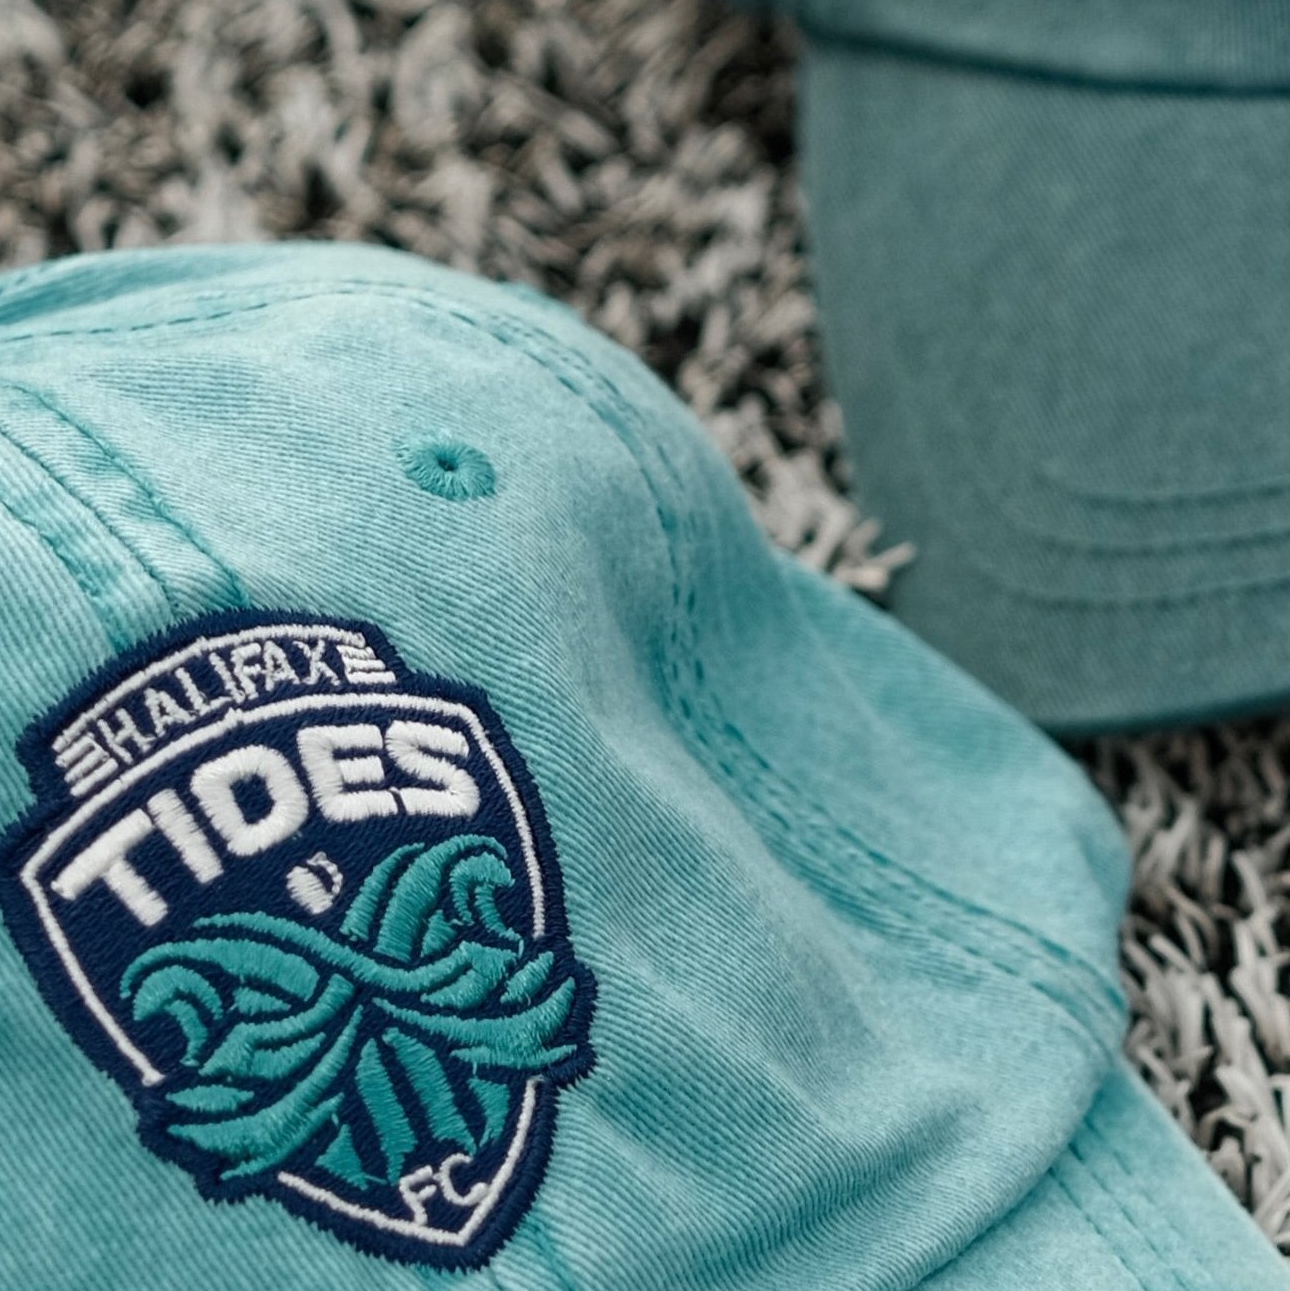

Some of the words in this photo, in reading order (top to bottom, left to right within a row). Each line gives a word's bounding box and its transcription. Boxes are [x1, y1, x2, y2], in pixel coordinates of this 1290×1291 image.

[97, 641, 341, 762] HALIFAX
[50, 719, 480, 927] TIDES
[399, 1153, 489, 1225] FC
